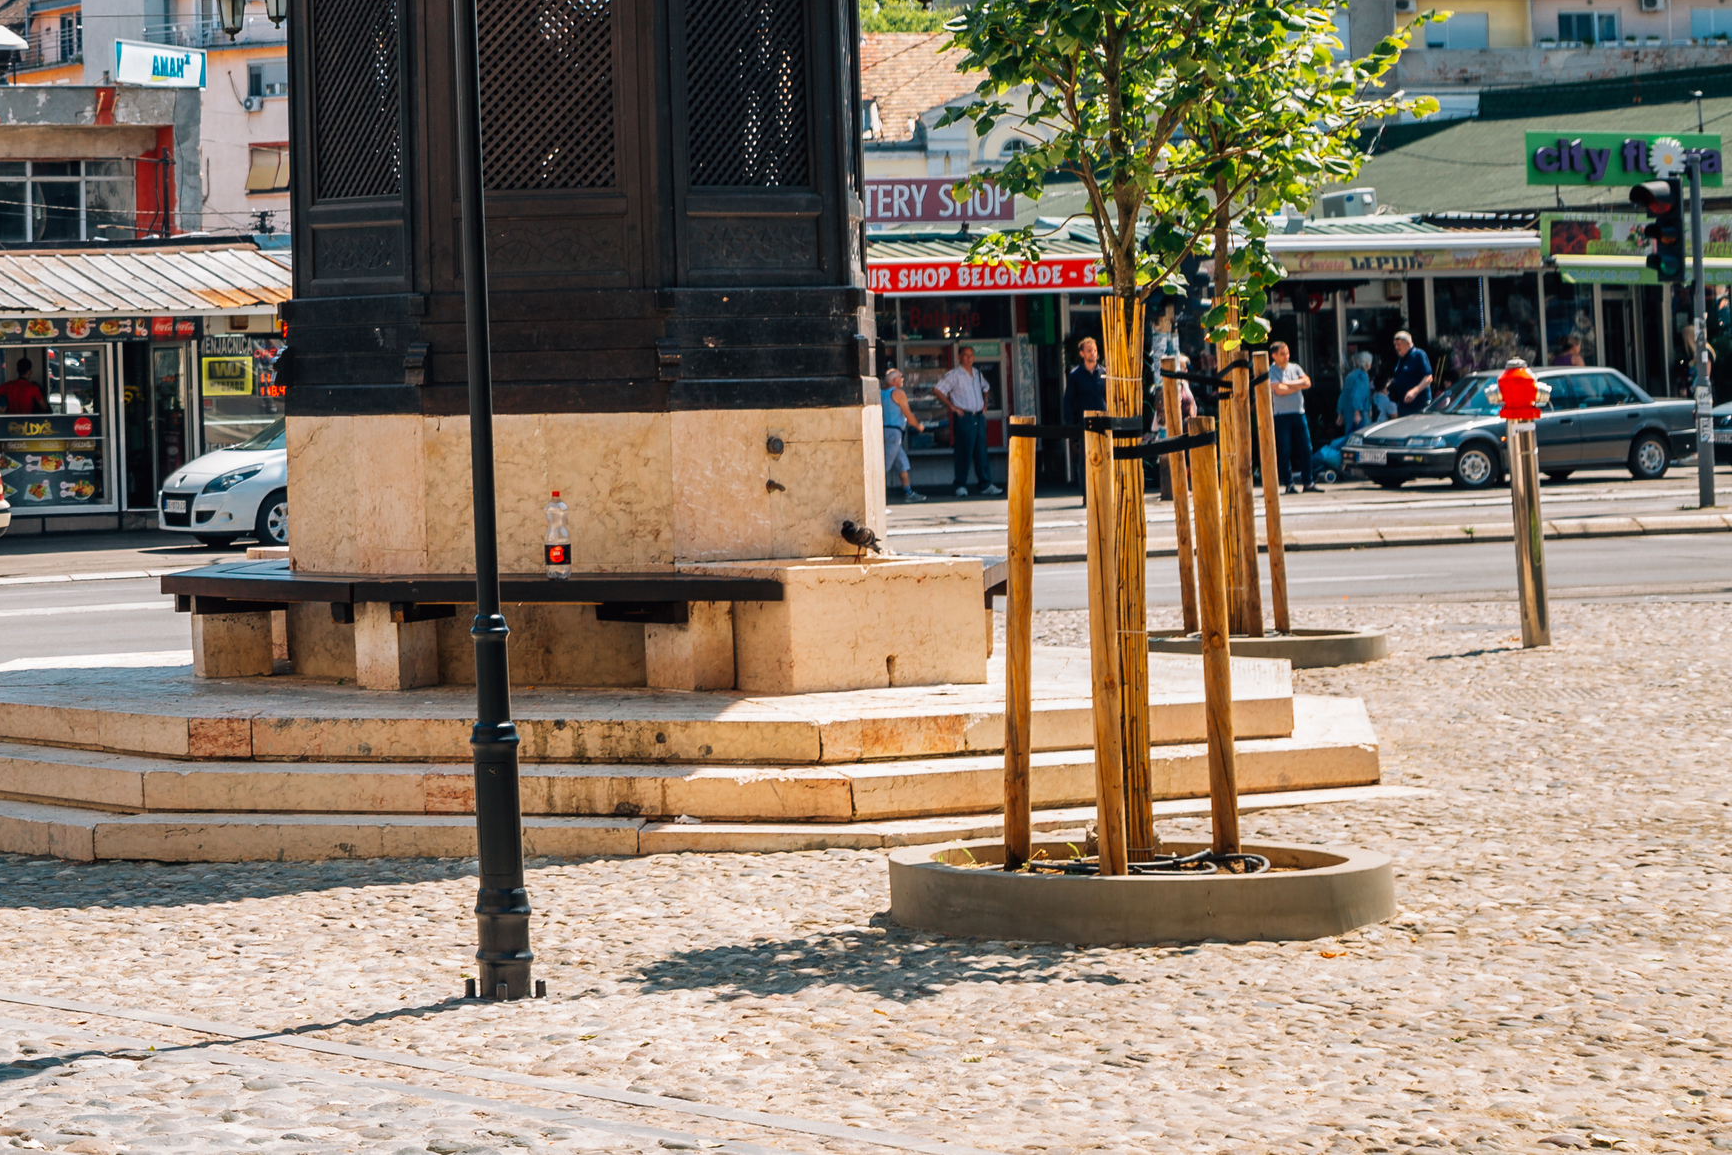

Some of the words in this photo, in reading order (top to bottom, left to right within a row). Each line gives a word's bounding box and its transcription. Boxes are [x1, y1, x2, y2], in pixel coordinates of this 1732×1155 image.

[152, 55, 184, 78] AMAN
[1534, 139, 1611, 181] city
[898, 266, 951, 288] SHOP
[957, 265, 1064, 287] BELGRADE
[910, 307, 981, 330] Baterije
[253, 348, 278, 359] OPE
